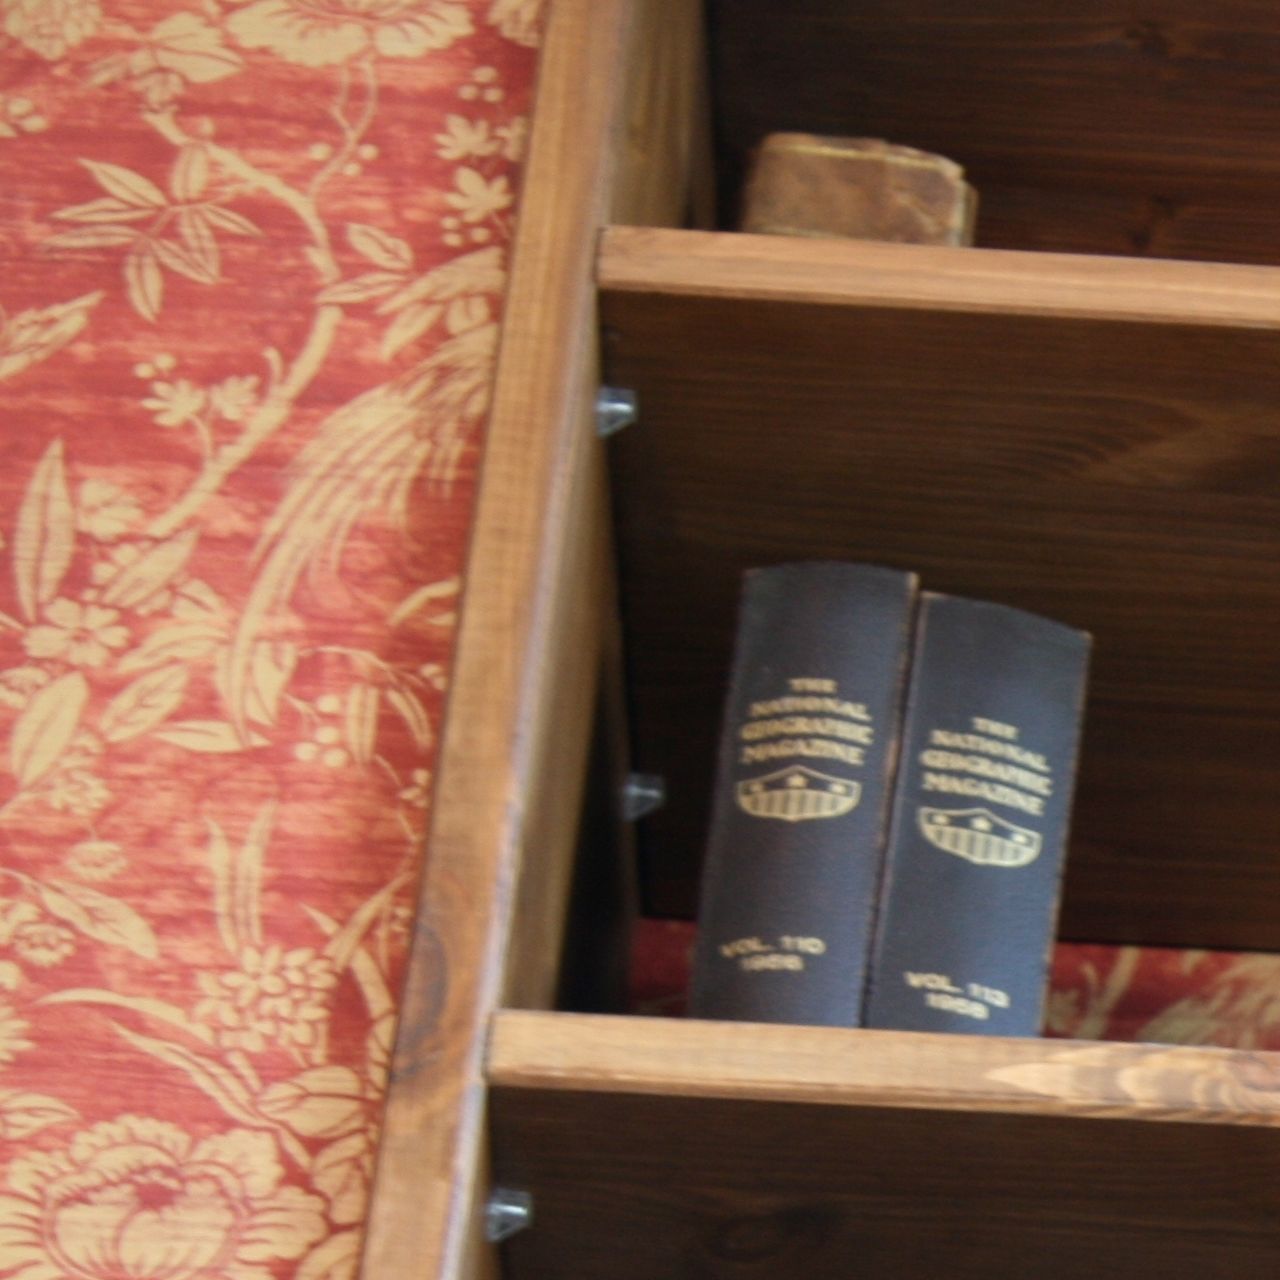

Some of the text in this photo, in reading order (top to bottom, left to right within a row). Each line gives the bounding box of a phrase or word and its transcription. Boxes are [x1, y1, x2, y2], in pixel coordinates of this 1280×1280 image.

[788, 677, 837, 694] THE
[750, 696, 873, 721] NATIONAL
[740, 716, 874, 745] GEOGRAPHIC
[972, 716, 1020, 740] THE
[740, 738, 865, 766] MAGAZINE
[931, 729, 1051, 772] NATIONAL
[919, 749, 1053, 795] GEOGRAPHIC
[922, 772, 1044, 817] MAGAZINE
